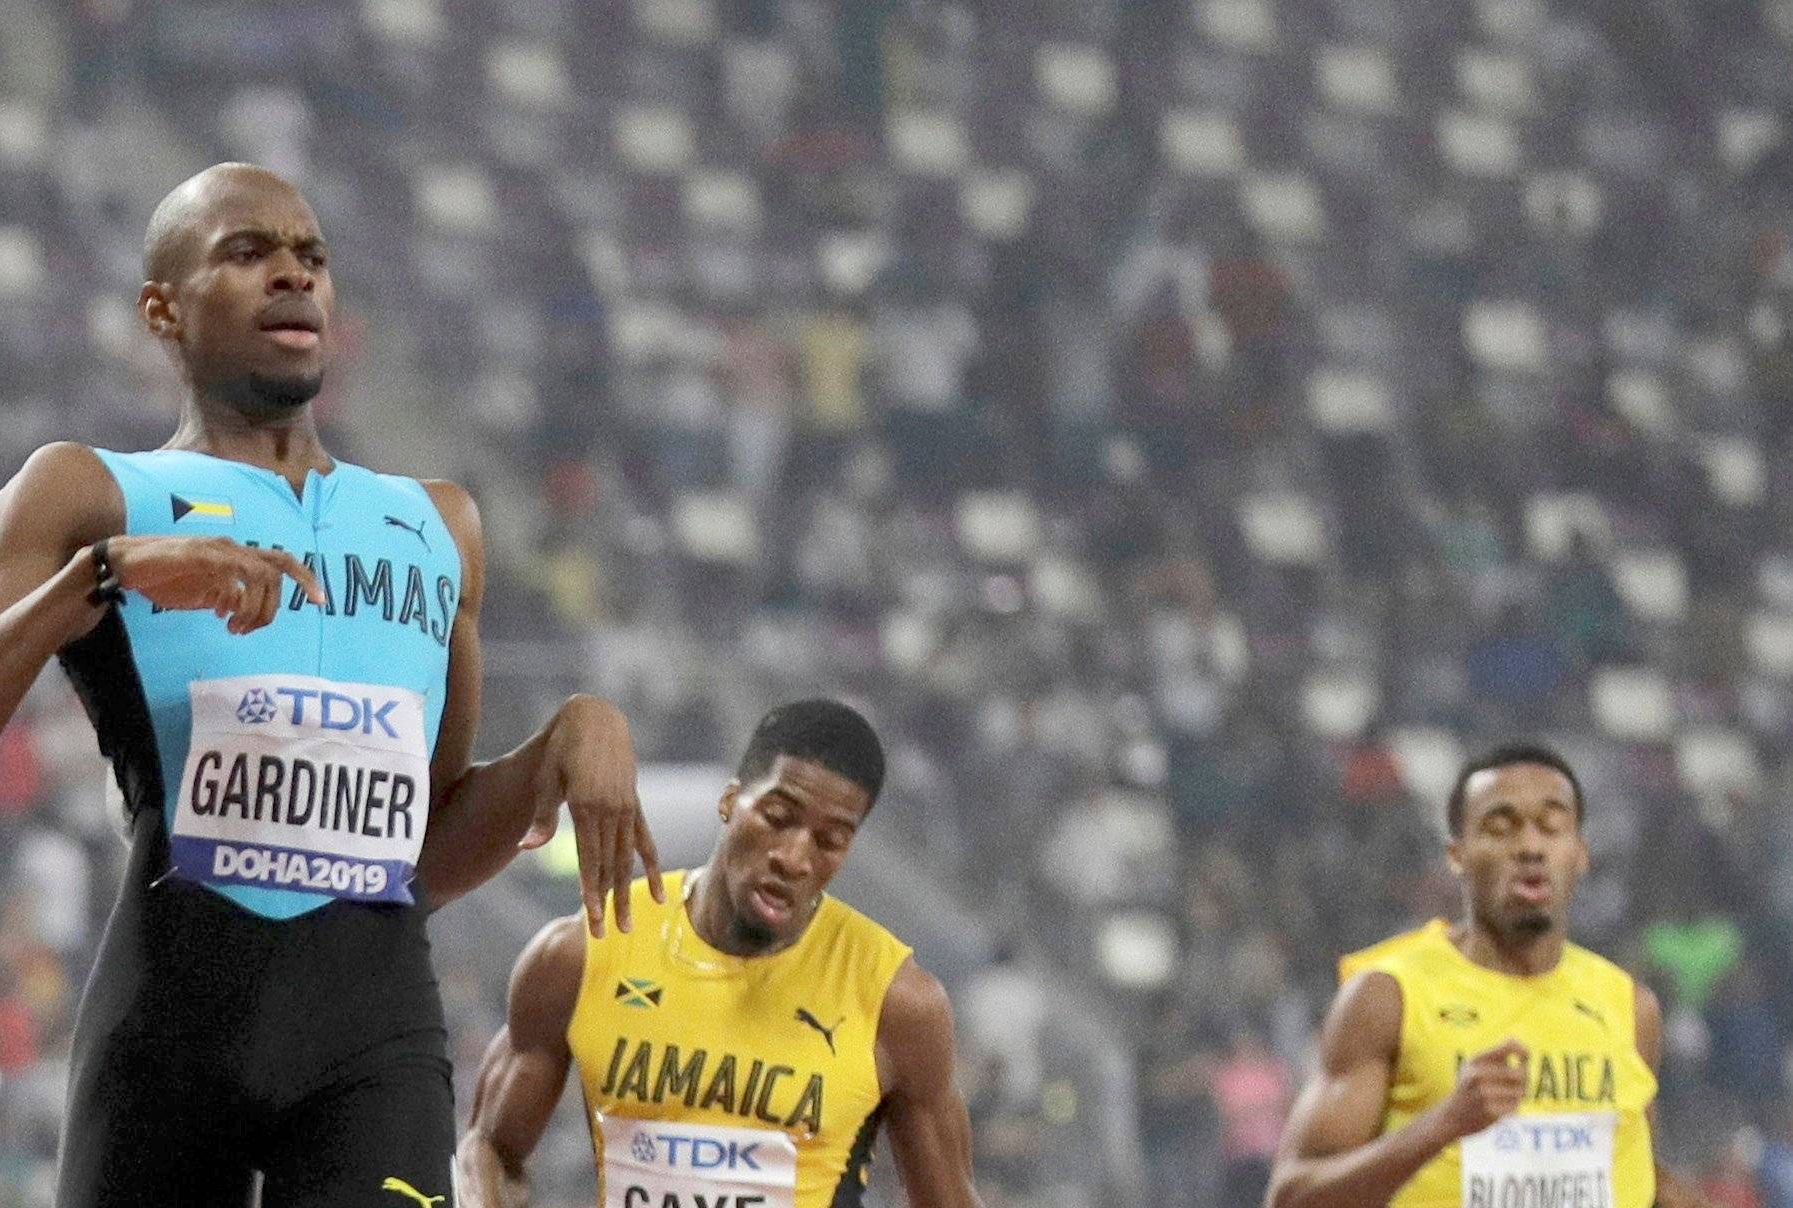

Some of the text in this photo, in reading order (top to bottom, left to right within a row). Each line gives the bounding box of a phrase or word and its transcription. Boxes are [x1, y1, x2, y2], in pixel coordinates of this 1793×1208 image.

[152, 540, 455, 648] AMAS
[276, 686, 402, 739] TDK
[190, 750, 417, 839] GARDINER
[212, 845, 388, 896] DOHA2019
[601, 1037, 824, 1134] JAMAICA
[656, 1134, 762, 1170] TDK
